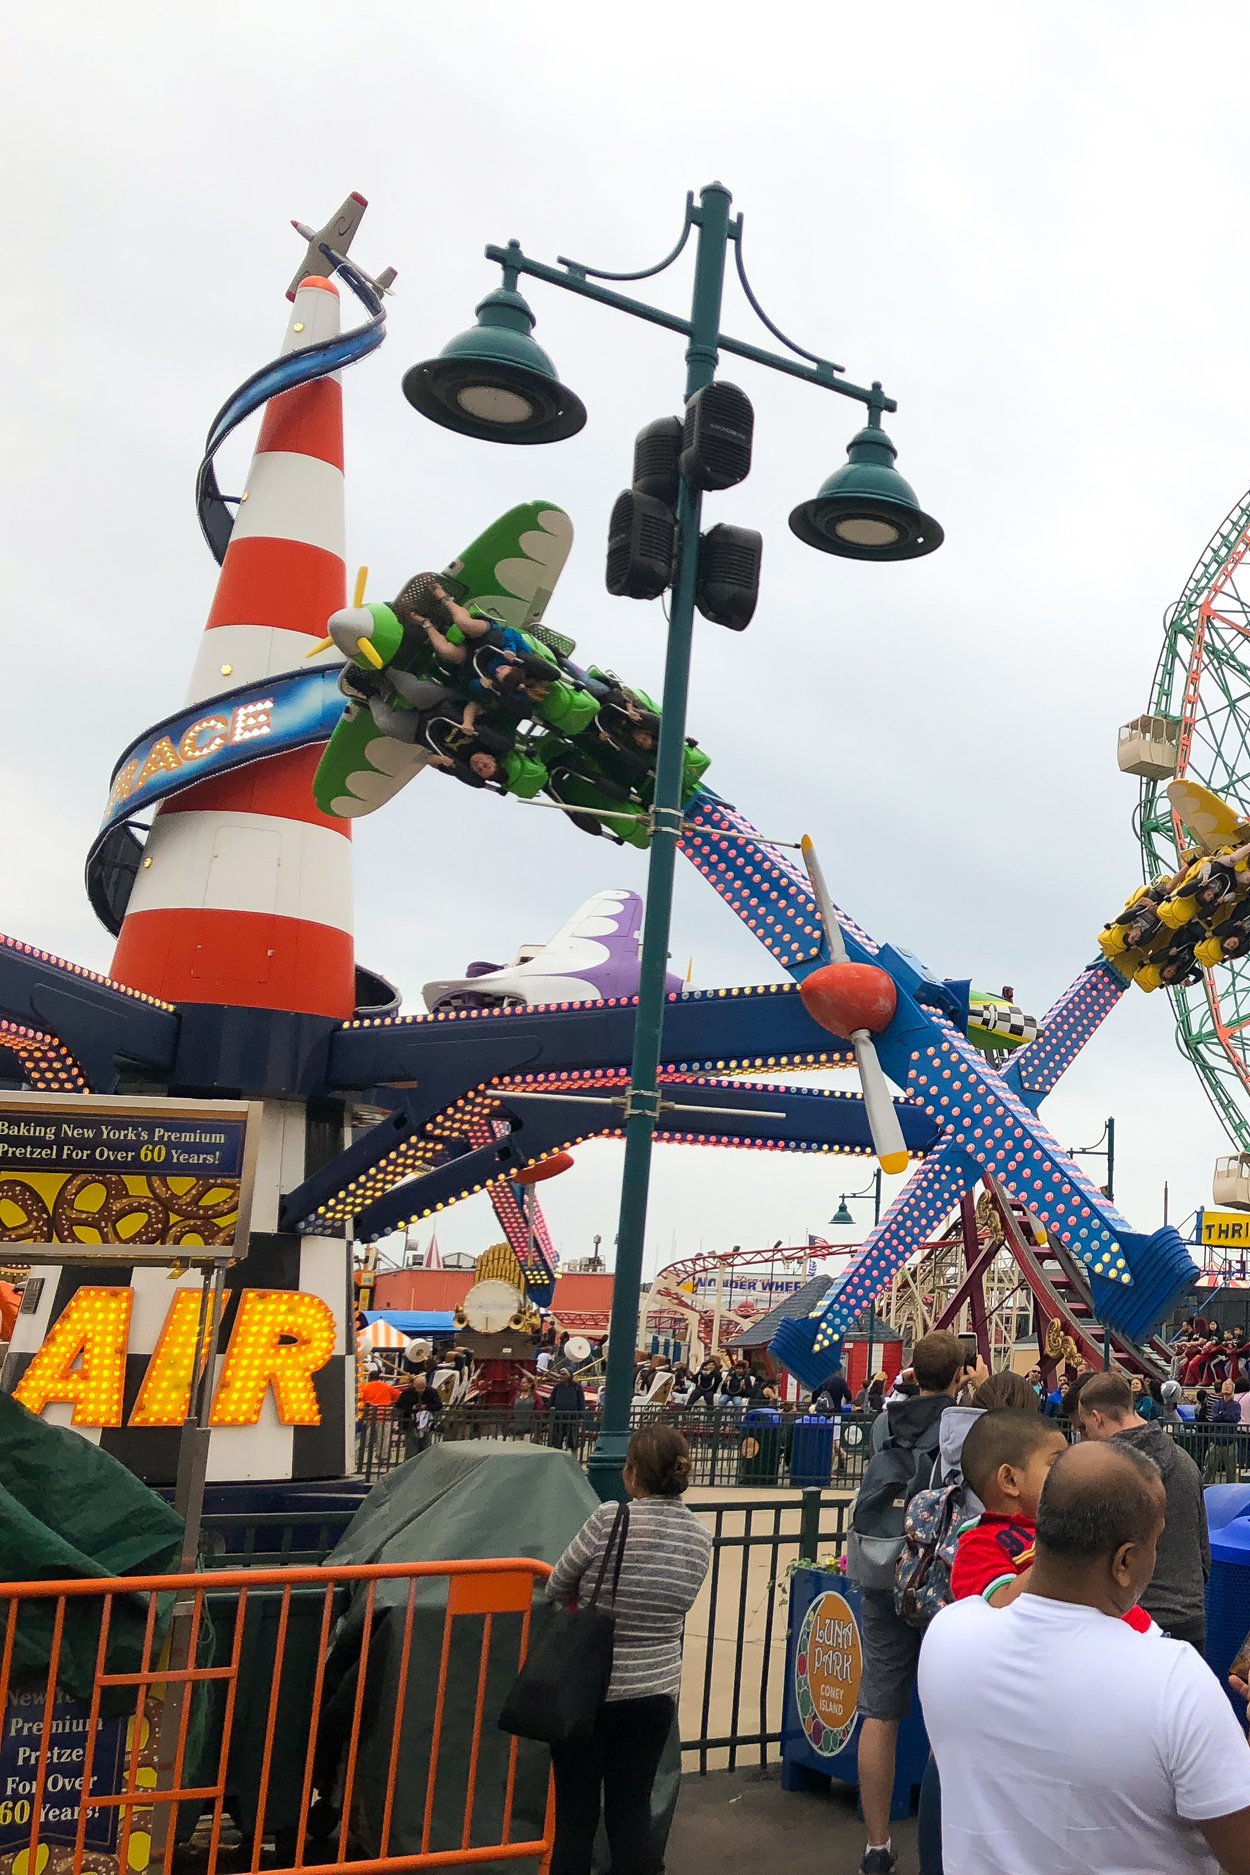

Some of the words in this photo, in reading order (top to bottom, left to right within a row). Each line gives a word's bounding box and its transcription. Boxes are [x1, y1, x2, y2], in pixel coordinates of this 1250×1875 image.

[0, 1121, 56, 1140] Baking
[61, 1124, 96, 1139] New
[100, 1125, 148, 1141] York's
[154, 1128, 225, 1144] Premium
[0, 1143, 57, 1159] Pretzel
[62, 1146, 91, 1160] For
[95, 1147, 135, 1161] Over
[139, 1144, 167, 1162] 60
[171, 1150, 220, 1164] Years!
[762, 1281, 801, 1292] WHEE
[12, 1286, 336, 1427] AIR
[815, 1615, 853, 1649] LUNA
[814, 1647, 852, 1684] PARK
[820, 1684, 844, 1699] CONEY
[819, 1699, 843, 1715] ISLAND
[0, 1800, 31, 1825] 60
